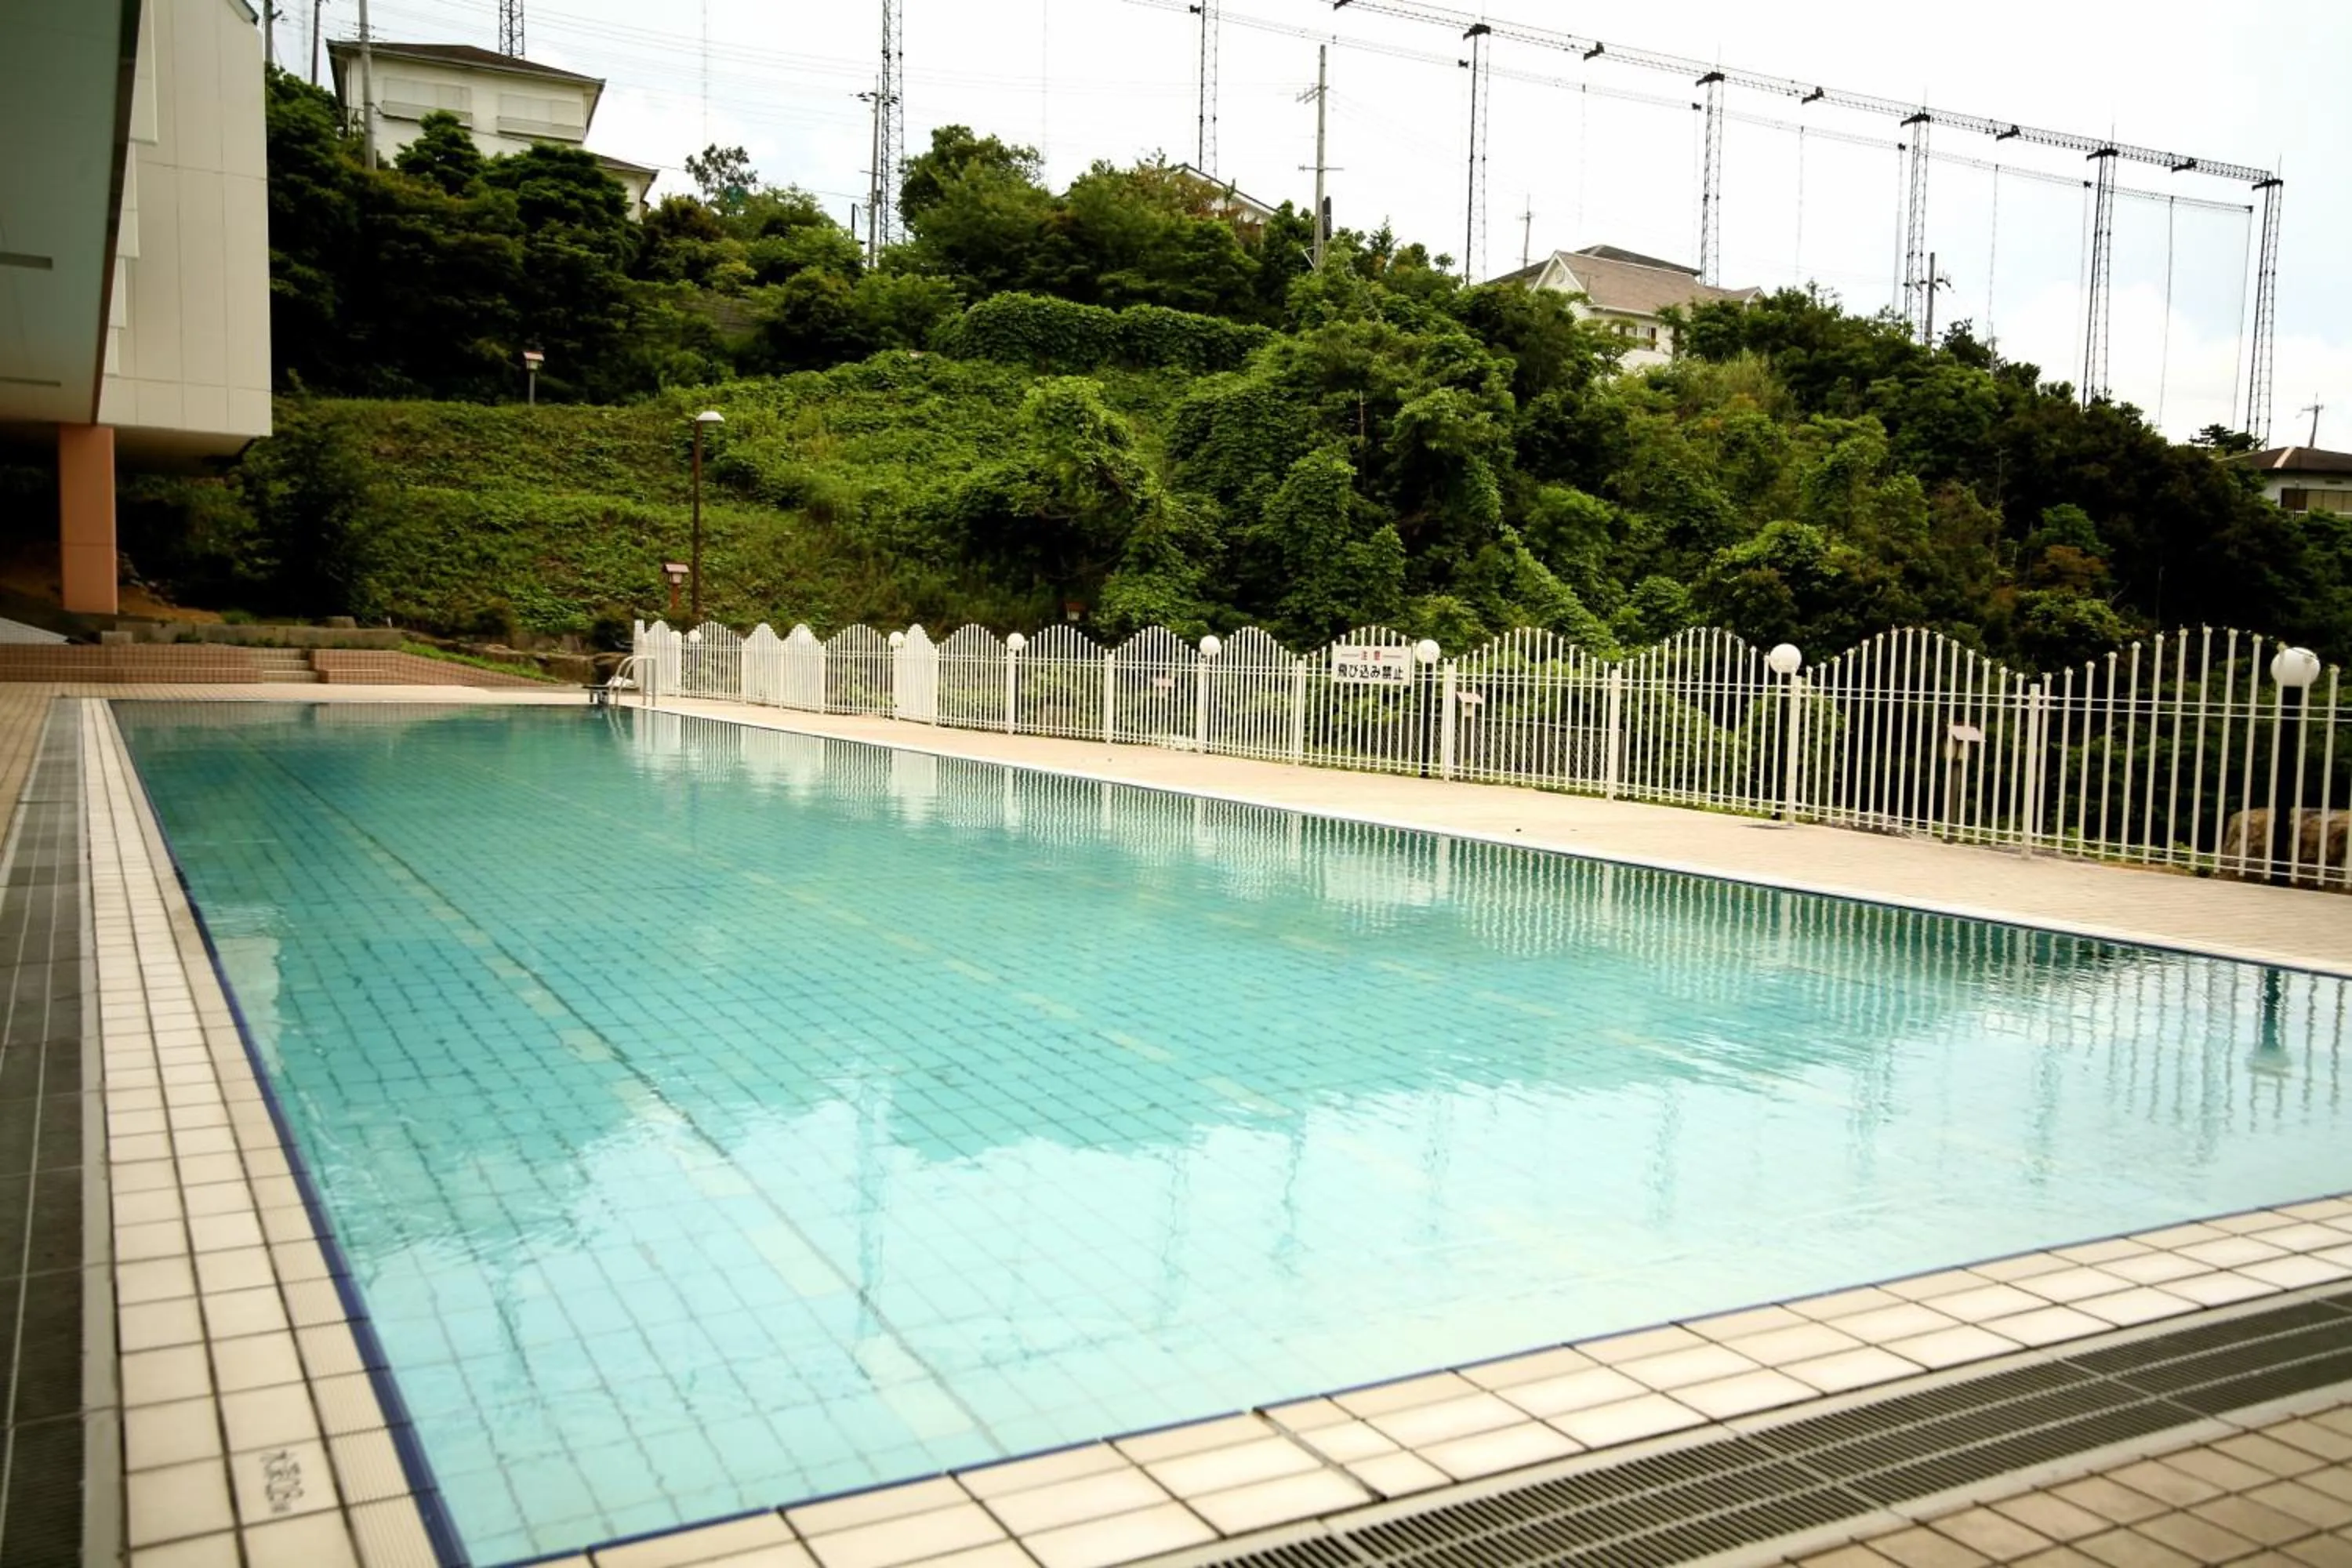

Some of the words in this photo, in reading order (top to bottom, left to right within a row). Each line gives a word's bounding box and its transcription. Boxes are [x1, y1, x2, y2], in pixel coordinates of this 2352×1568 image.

[1337, 662, 1403, 681] 飛び込み禁止
